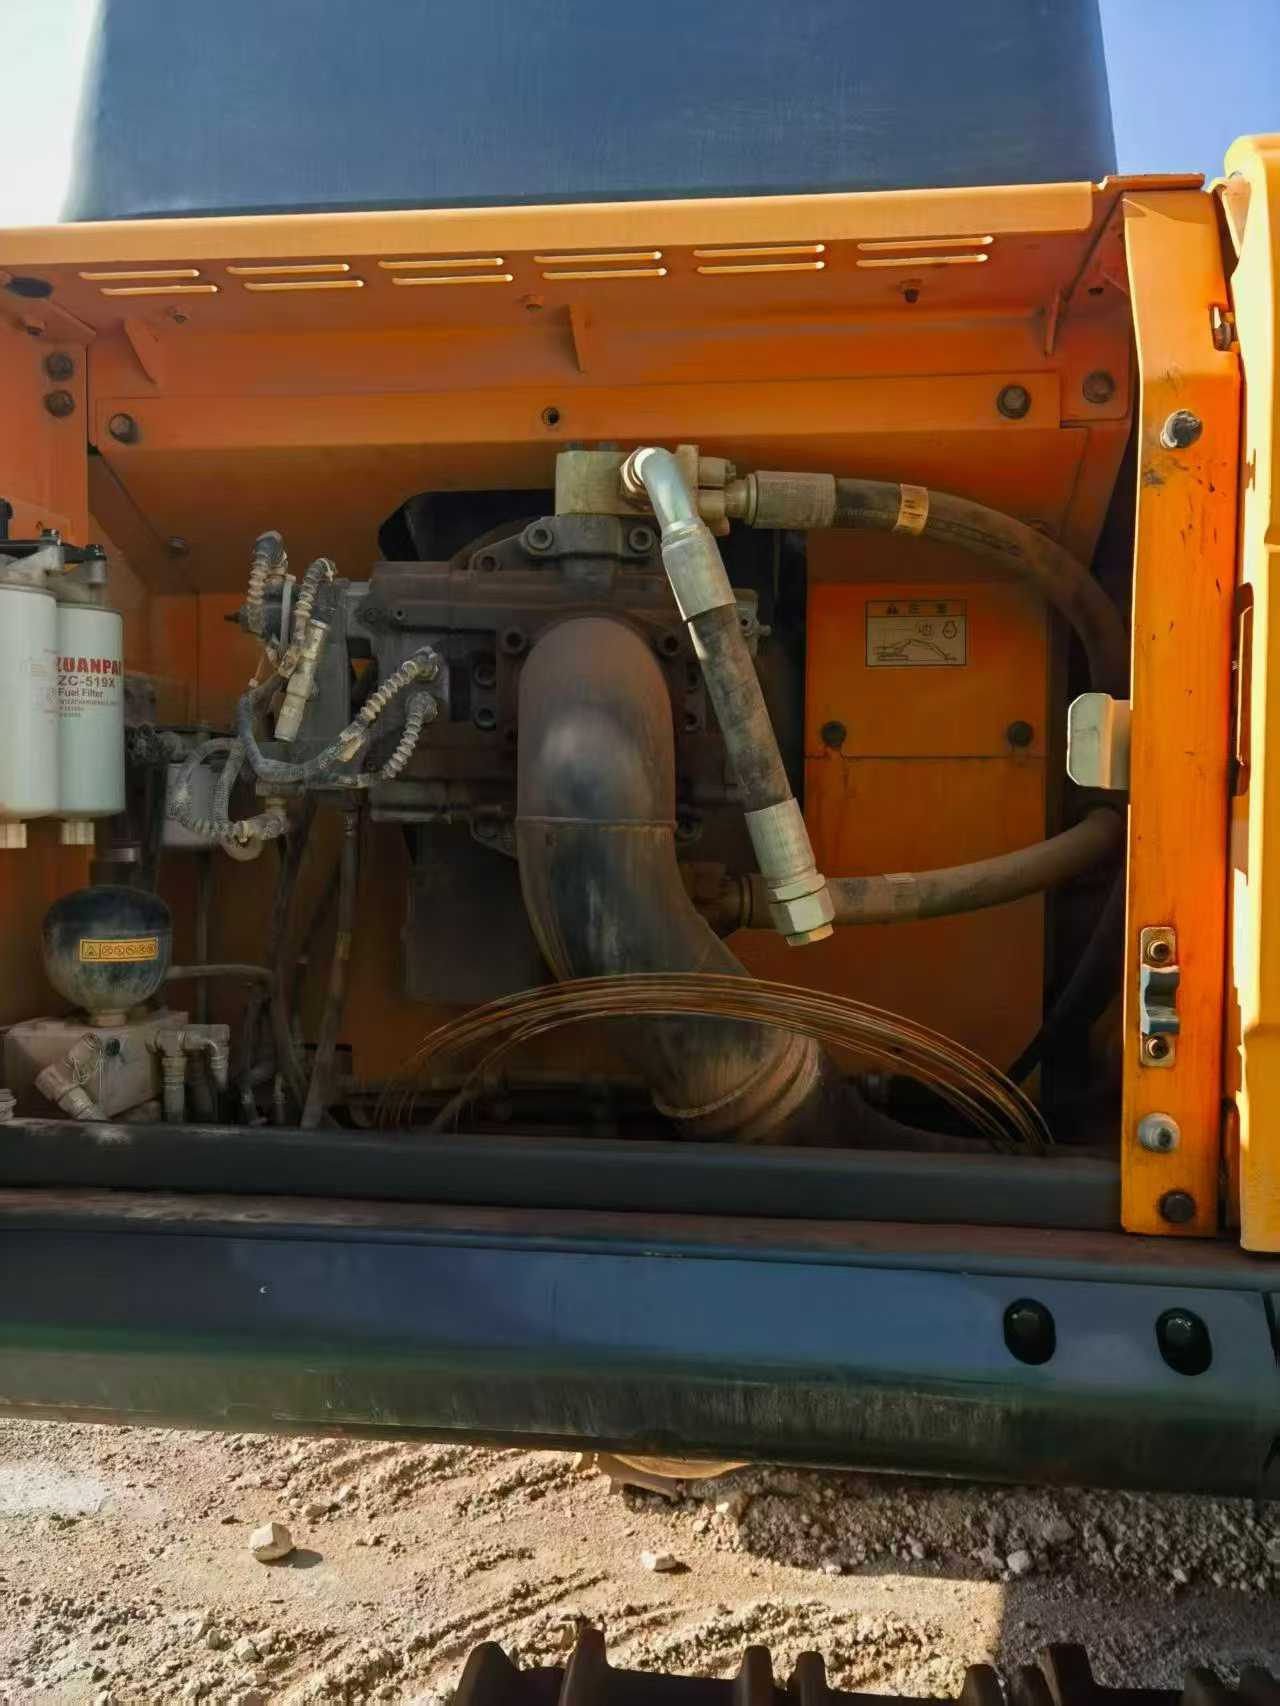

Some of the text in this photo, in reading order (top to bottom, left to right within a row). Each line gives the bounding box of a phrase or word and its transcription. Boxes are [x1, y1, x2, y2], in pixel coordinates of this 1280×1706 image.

[57, 674, 116, 688] ZC-519X
[58, 688, 104, 698] Fuel Filter
